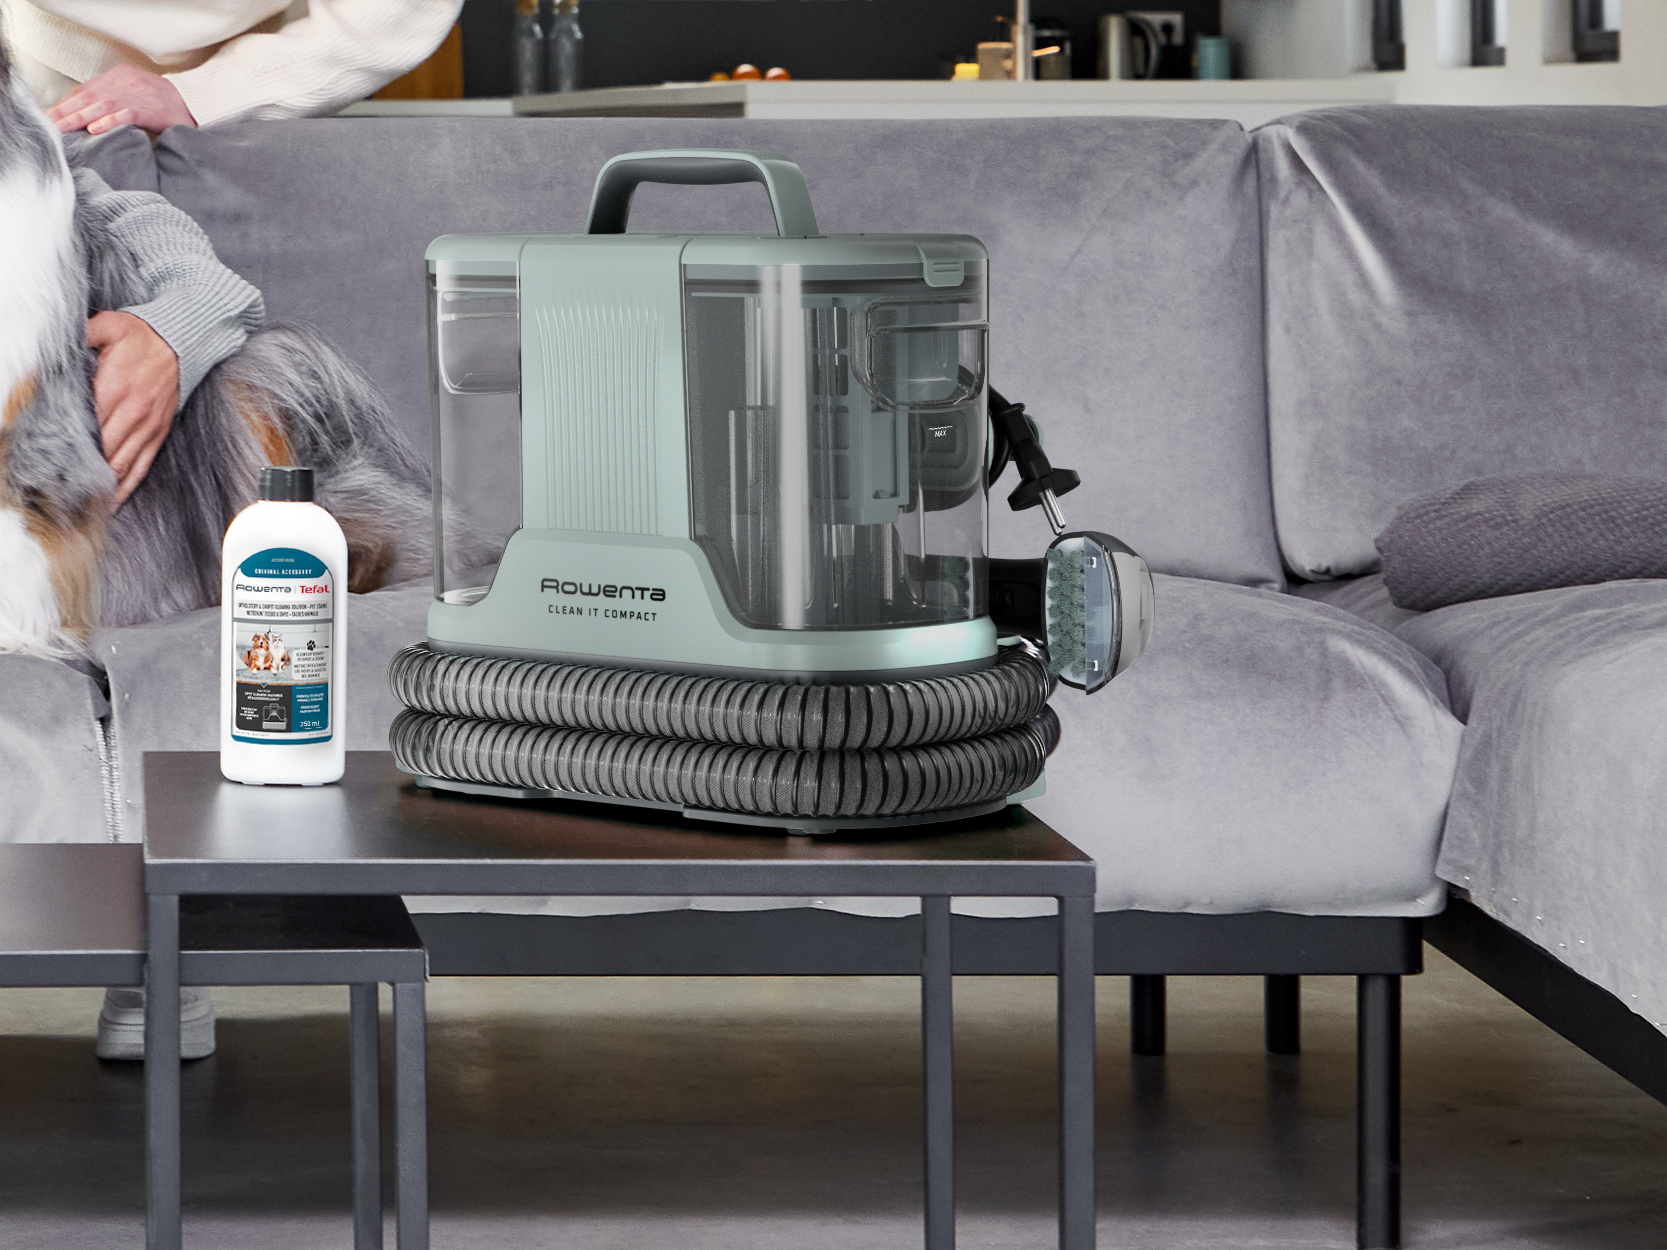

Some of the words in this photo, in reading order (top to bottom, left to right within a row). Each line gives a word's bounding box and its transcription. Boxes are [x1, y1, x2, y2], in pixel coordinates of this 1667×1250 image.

[934, 429, 947, 438] MAX
[235, 583, 292, 593] Rowenta
[299, 584, 330, 594] Tefal
[541, 578, 666, 602] Rowenta
[548, 604, 583, 616] CLEAN
[588, 608, 599, 617] IT
[604, 609, 657, 622] COMPACT
